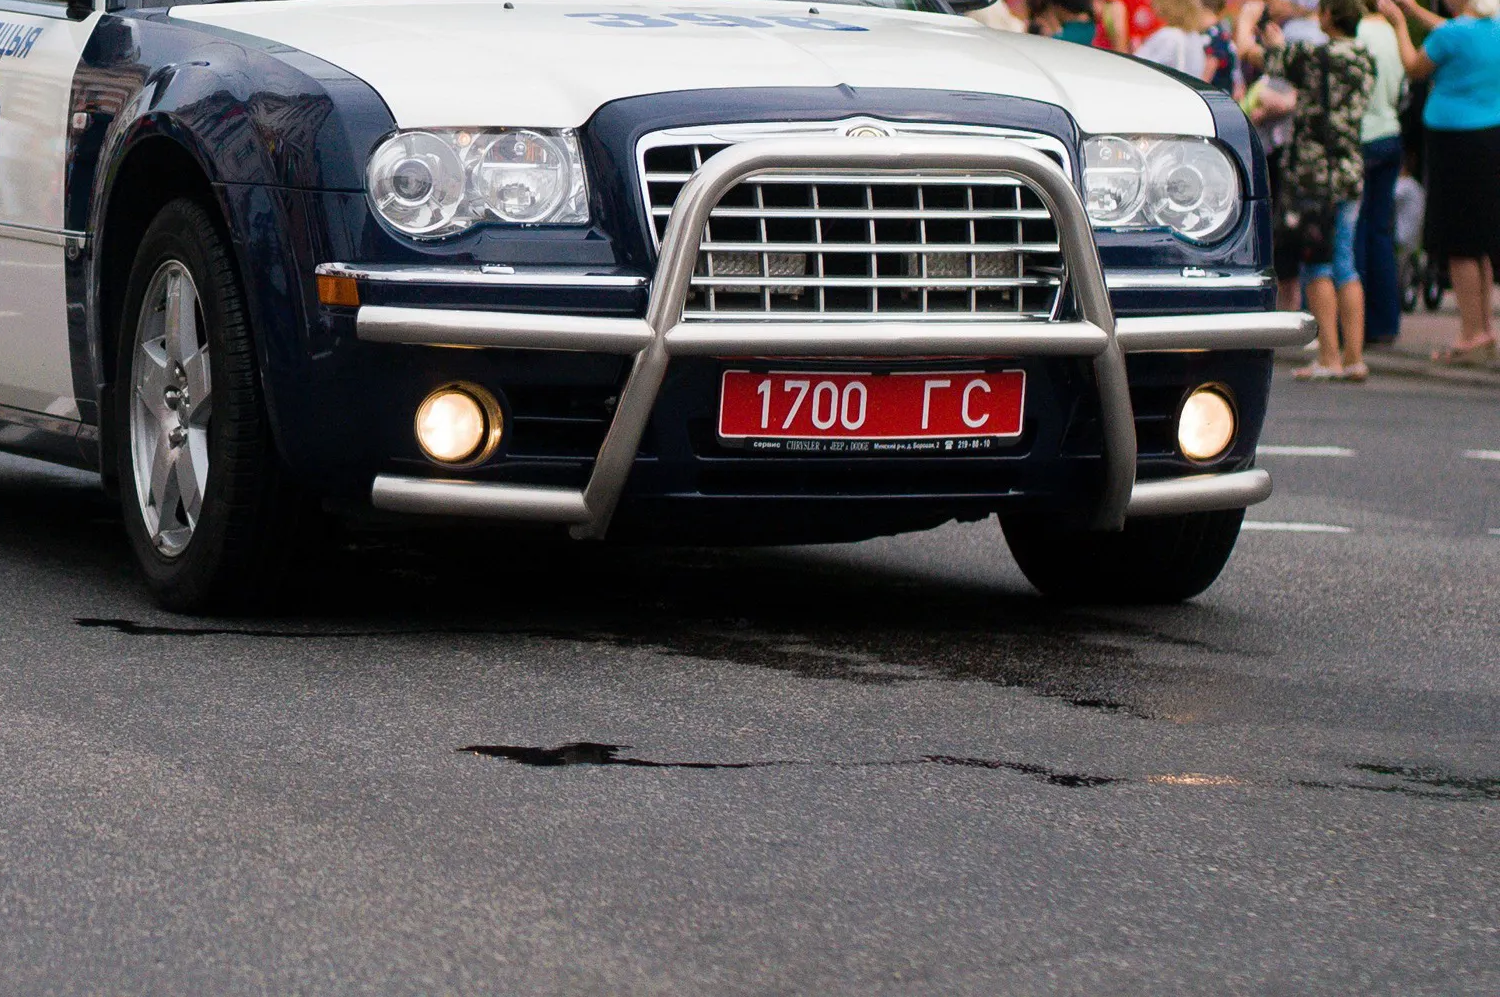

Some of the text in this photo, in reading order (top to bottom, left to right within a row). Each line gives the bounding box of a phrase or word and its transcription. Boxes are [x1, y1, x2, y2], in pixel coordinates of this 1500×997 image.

[564, 12, 870, 32] 398
[757, 379, 991, 430] 1700 ГС
[753, 441, 781, 449] сервис
[786, 440, 820, 450] CHRYSLER
[829, 441, 845, 451] JEEP
[850, 441, 869, 451] DODGE
